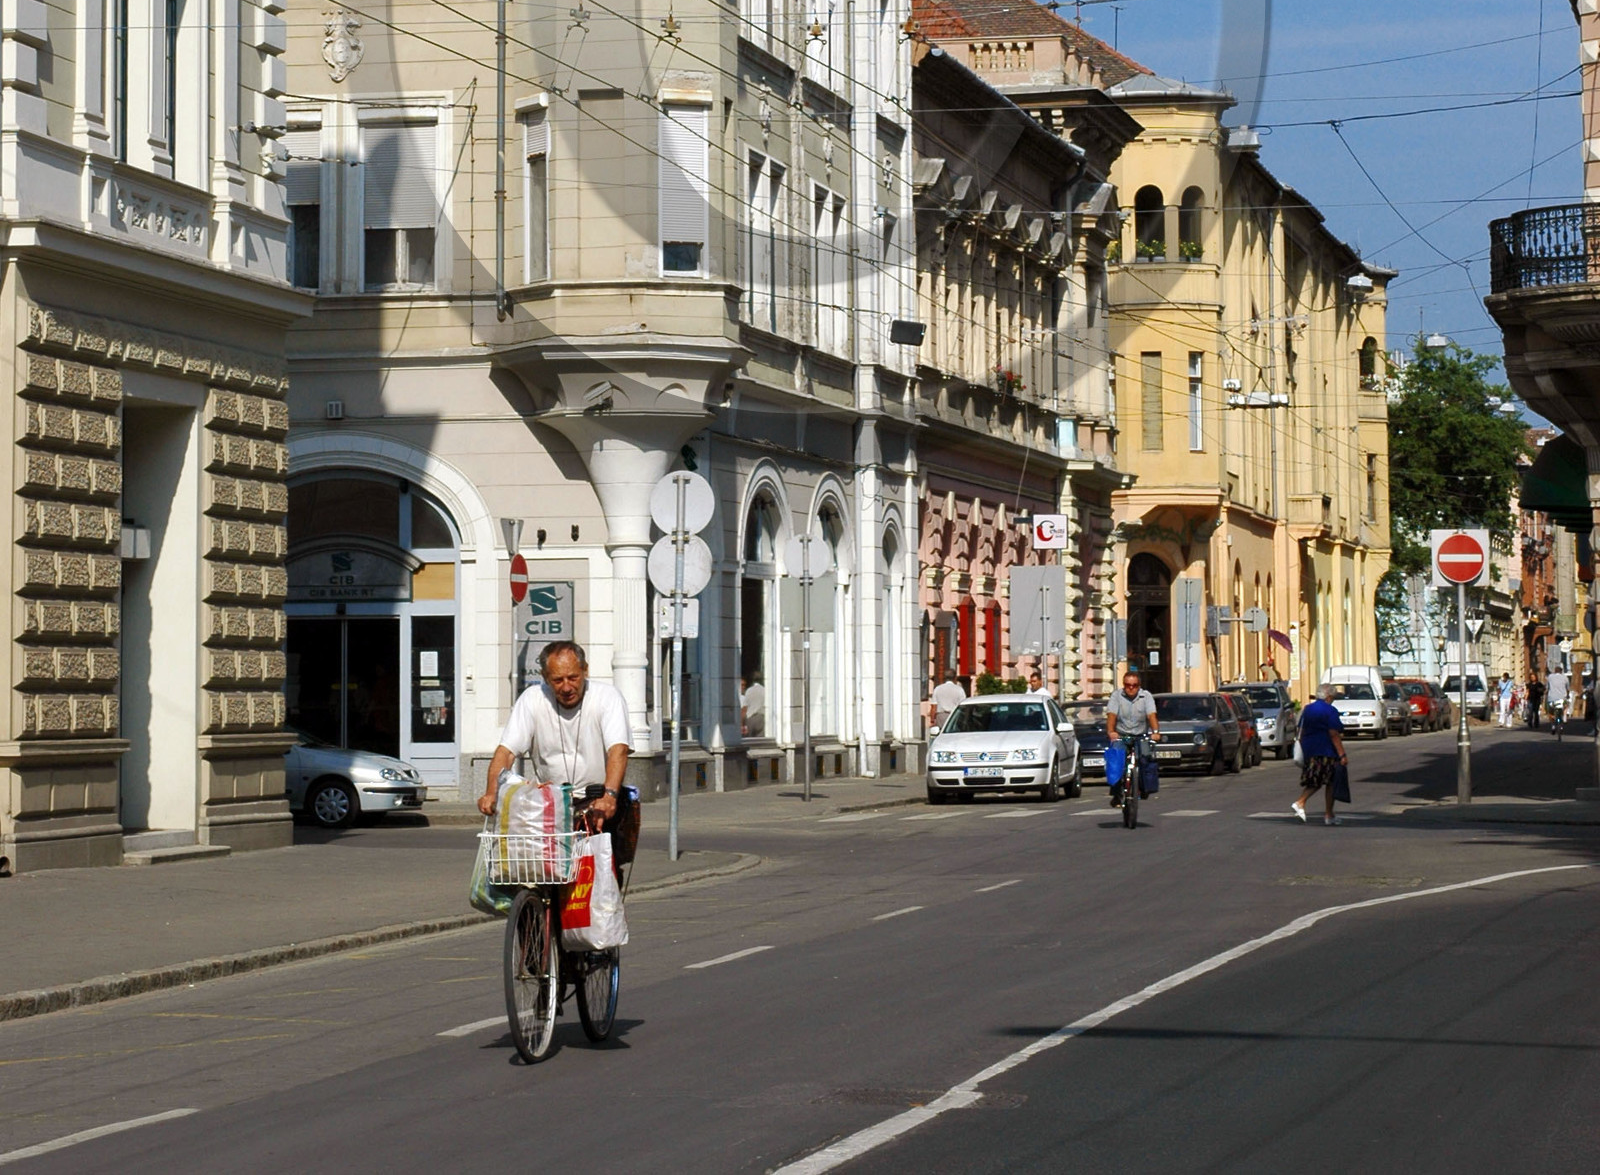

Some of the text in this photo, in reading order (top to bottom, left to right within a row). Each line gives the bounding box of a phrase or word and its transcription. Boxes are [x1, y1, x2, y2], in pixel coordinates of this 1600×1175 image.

[329, 575, 354, 585] CIB
[330, 589, 358, 598] BANK
[525, 620, 562, 635] CIB
